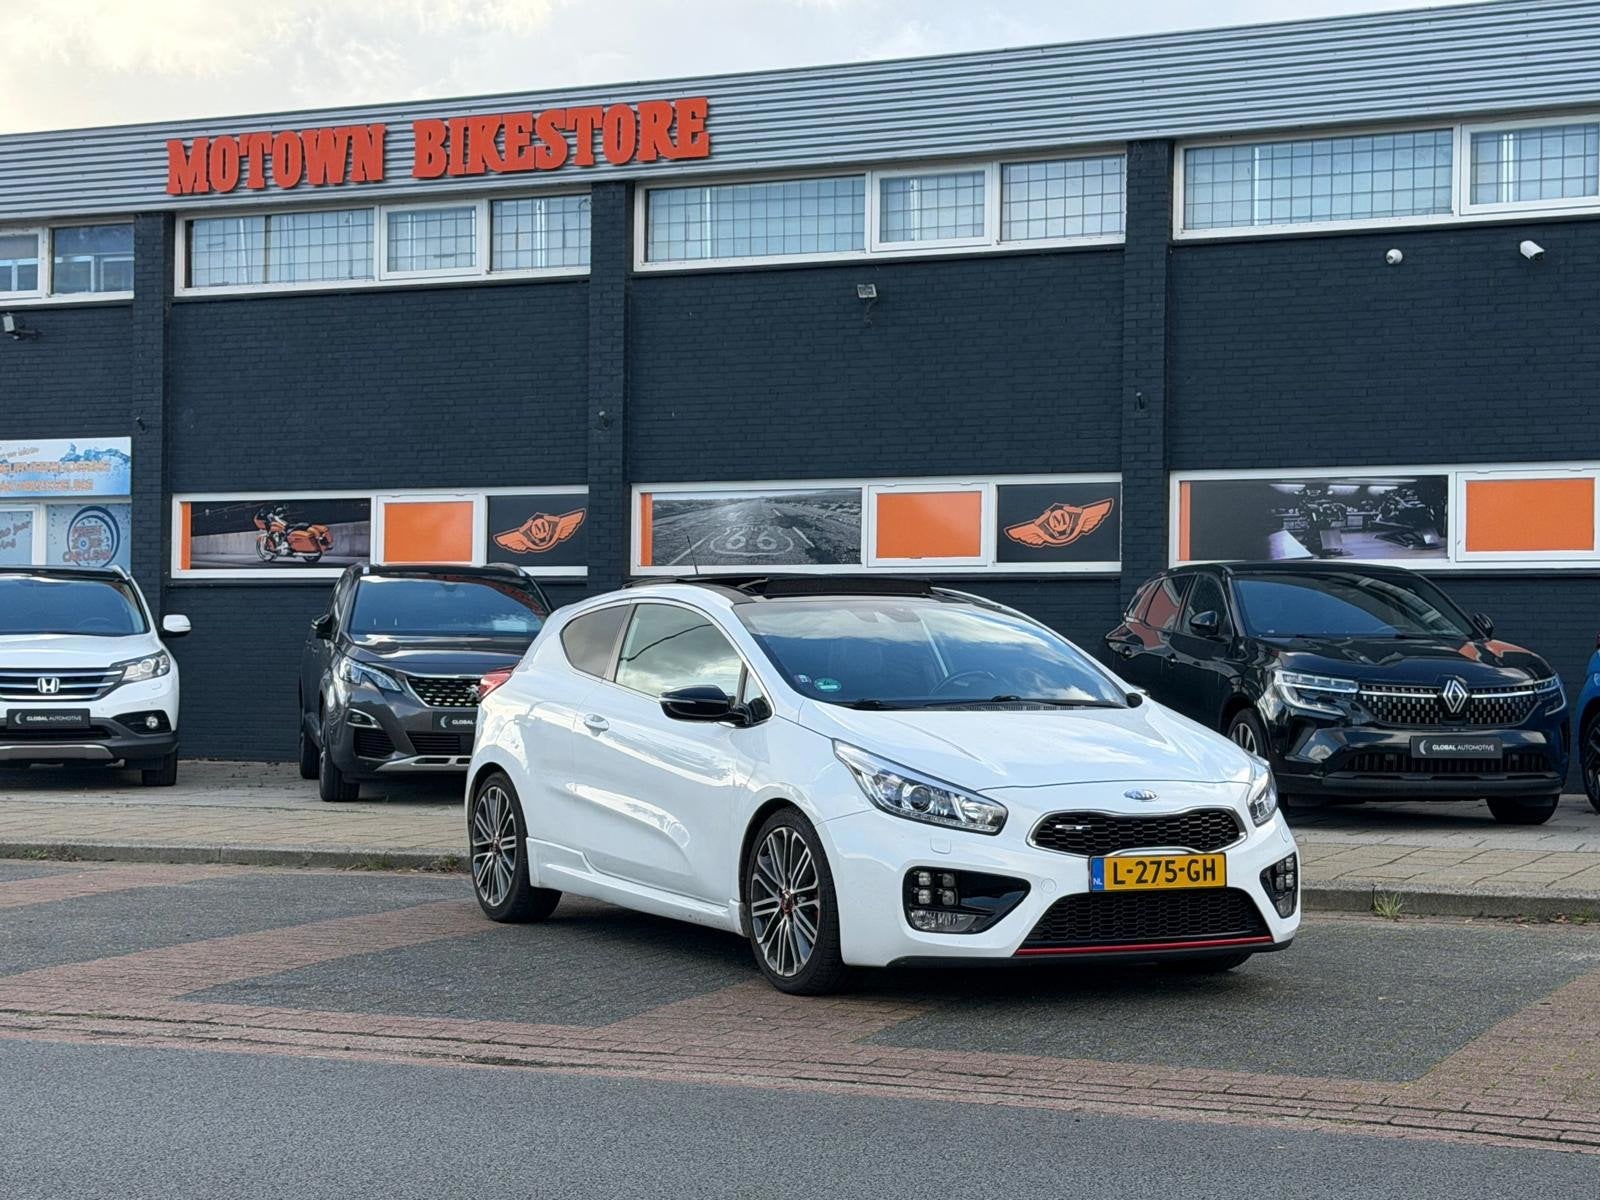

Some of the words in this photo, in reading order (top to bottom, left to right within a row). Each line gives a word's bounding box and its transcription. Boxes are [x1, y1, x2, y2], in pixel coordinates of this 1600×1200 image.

[166, 123, 386, 195] MOTOWN
[412, 96, 711, 179] BIKESTORE
[1432, 743, 1456, 751] GLOBAL
[1457, 743, 1495, 752] AUTOMOTIVE
[1093, 877, 1103, 886] NL
[1112, 858, 1217, 886] L-275-GH
